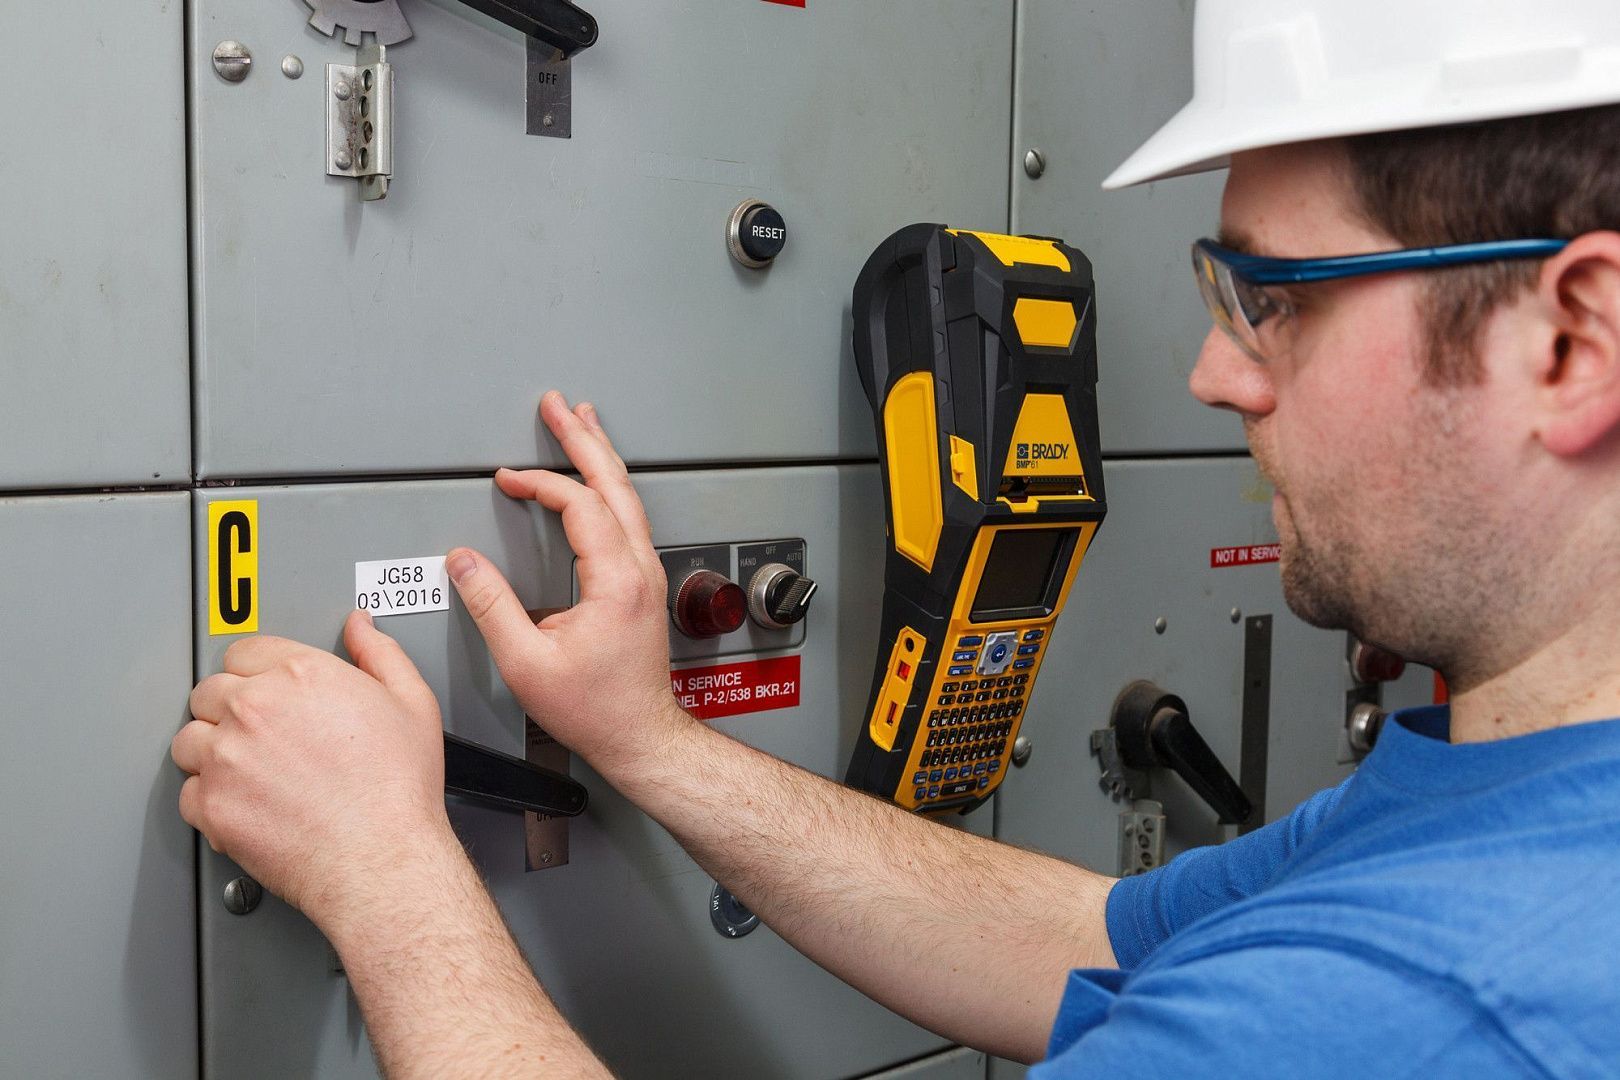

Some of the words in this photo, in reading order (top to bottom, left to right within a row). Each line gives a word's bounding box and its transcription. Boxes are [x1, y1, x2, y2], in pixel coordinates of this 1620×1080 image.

[538, 71, 557, 85] OFF
[752, 225, 785, 240] RESET
[1031, 443, 1069, 459] BRADY
[765, 545, 777, 555] OFF
[786, 552, 802, 562] AUTO
[1215, 549, 1236, 564] NOT
[1238, 548, 1249, 562] IN
[218, 510, 252, 625] C
[377, 566, 424, 586] JG58
[357, 587, 442, 611] 03\2016
[688, 671, 742, 691] SERVICE
[704, 687, 751, 706] P-2/538
[755, 681, 796, 700] BKR.21
